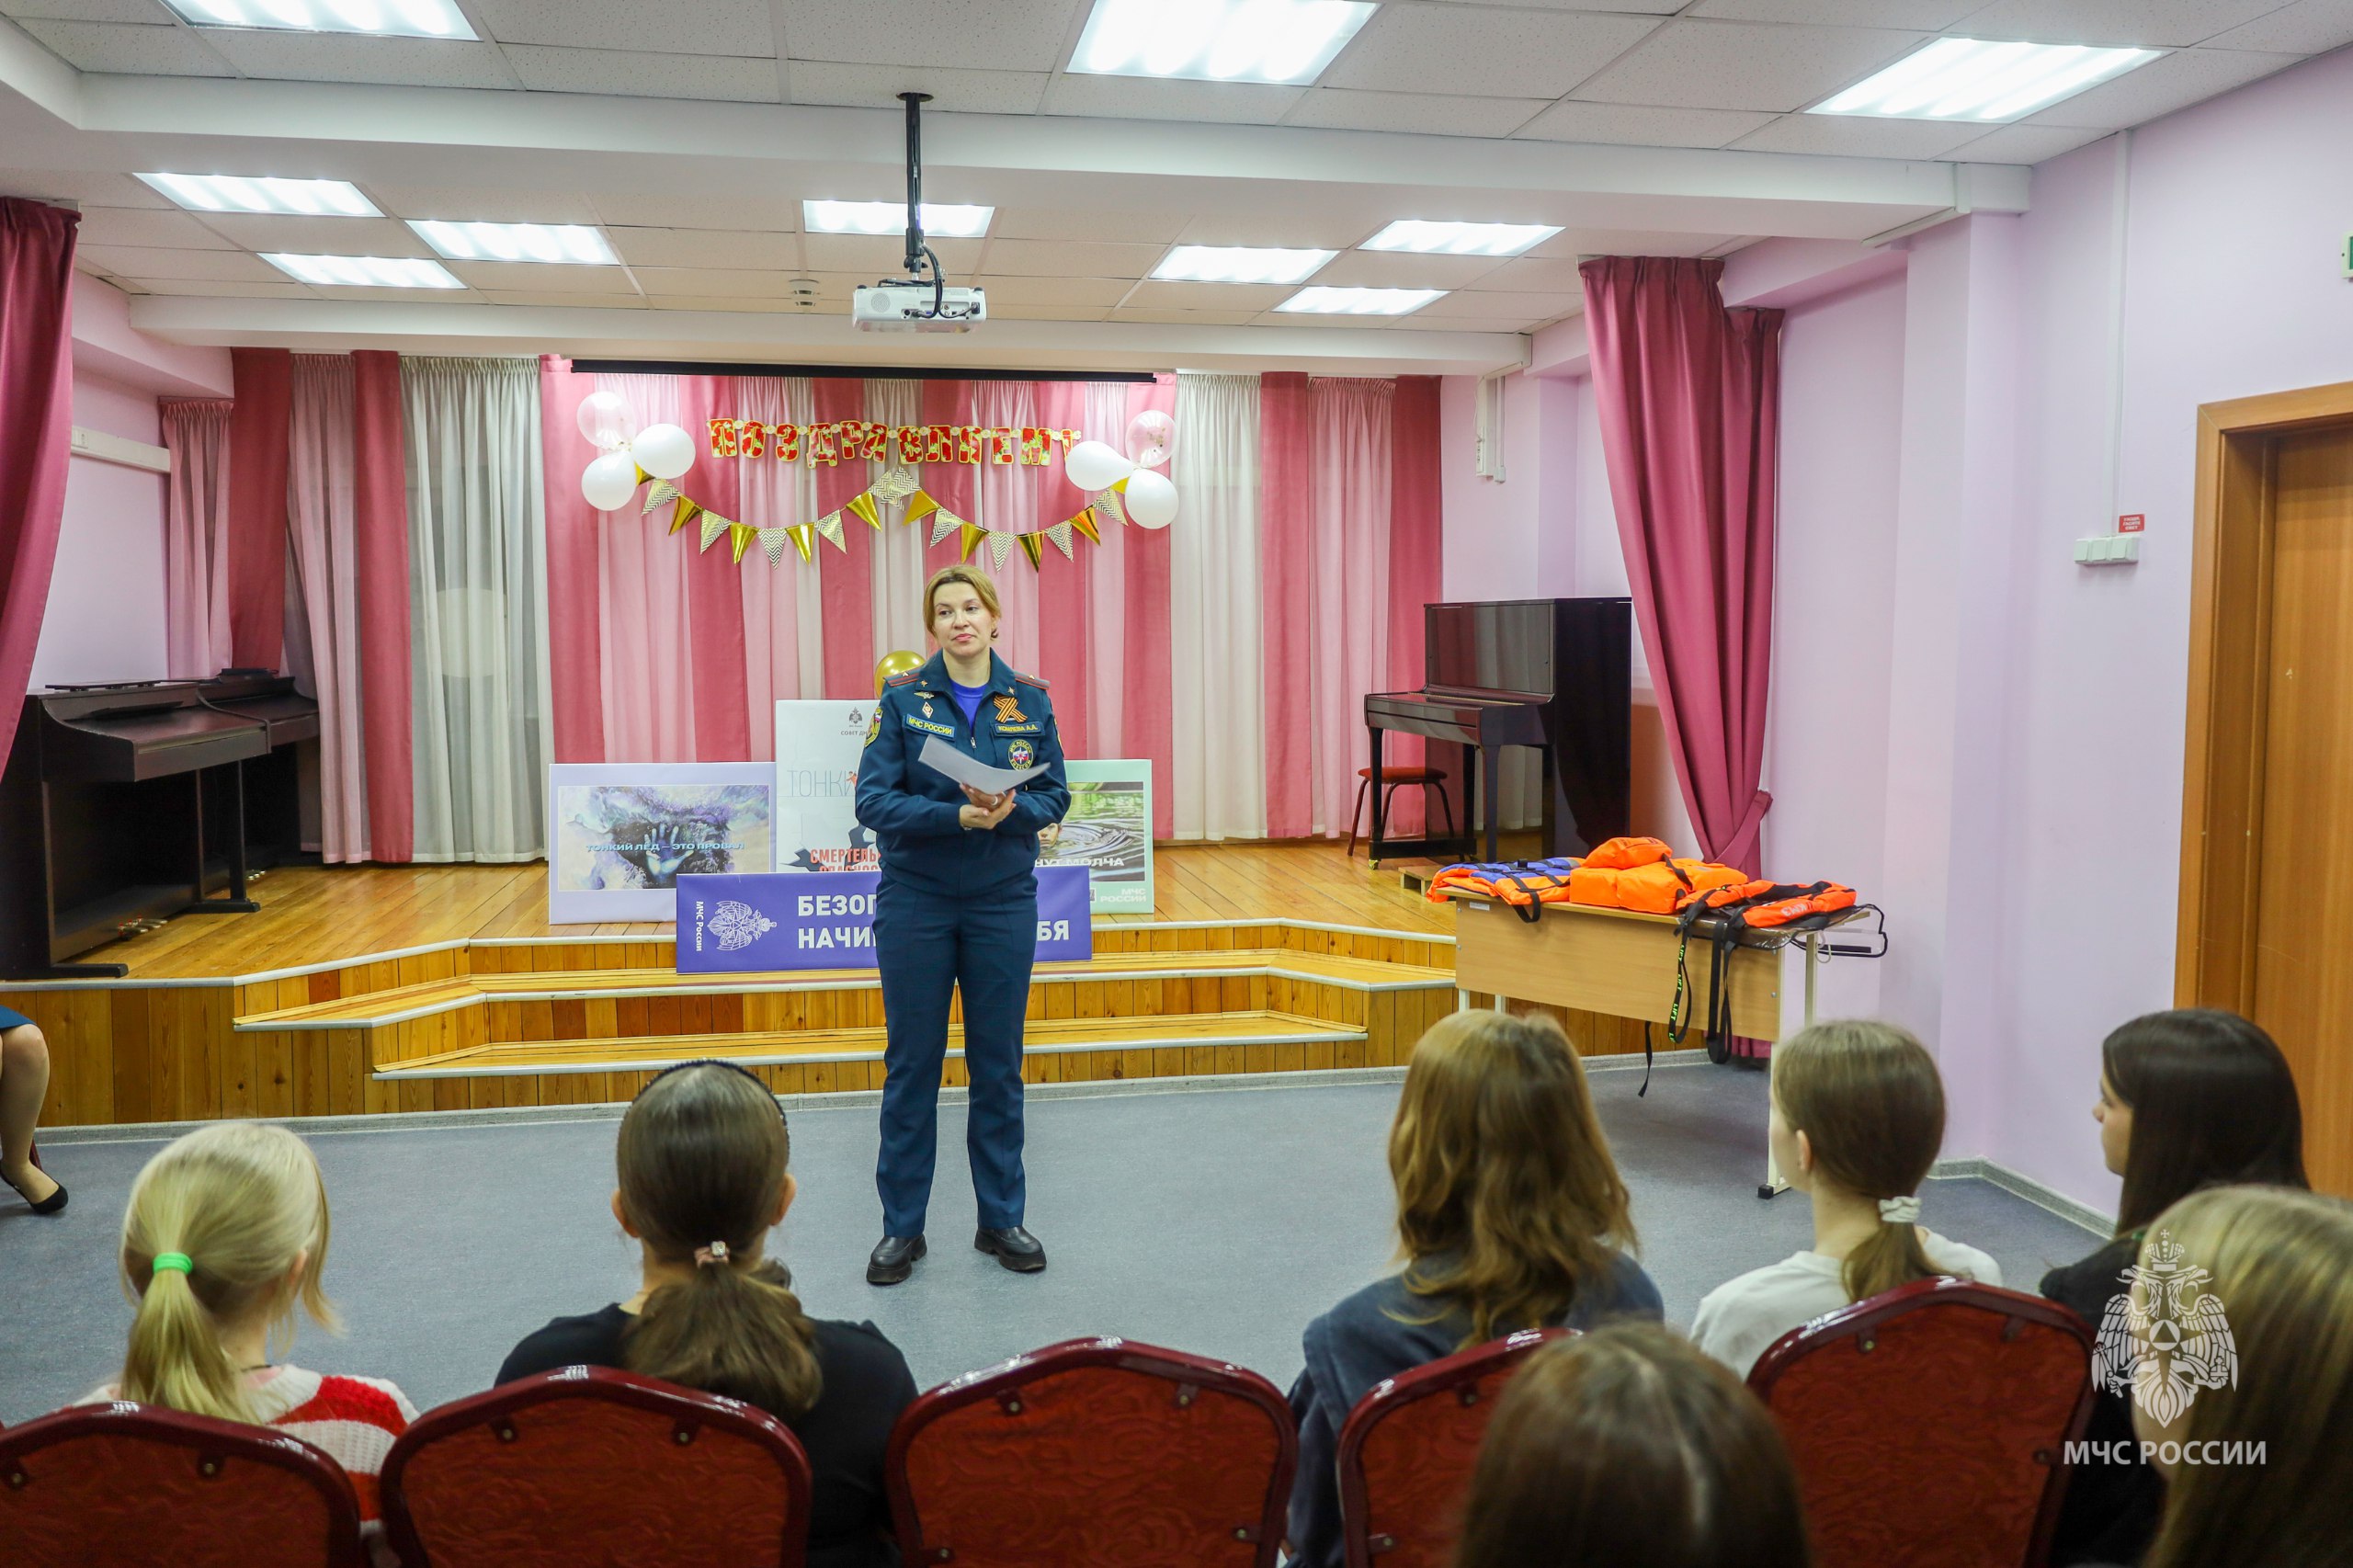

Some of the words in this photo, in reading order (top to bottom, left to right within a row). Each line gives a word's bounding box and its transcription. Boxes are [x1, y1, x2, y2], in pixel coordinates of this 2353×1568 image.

[908, 717, 924, 729] МЧС
[924, 722, 952, 734] РОССИИ
[587, 843, 633, 852] ТОНКИЙ
[697, 842, 745, 850] ПРОВАЛ
[810, 848, 881, 863] СМЕРТЕЛЬ
[1065, 858, 1125, 867] МОЛЧА
[696, 901, 704, 920] МЧС
[696, 921, 704, 951] России
[798, 926, 877, 949] НАЧИ
[1670, 1003, 1678, 1022] LIFT
